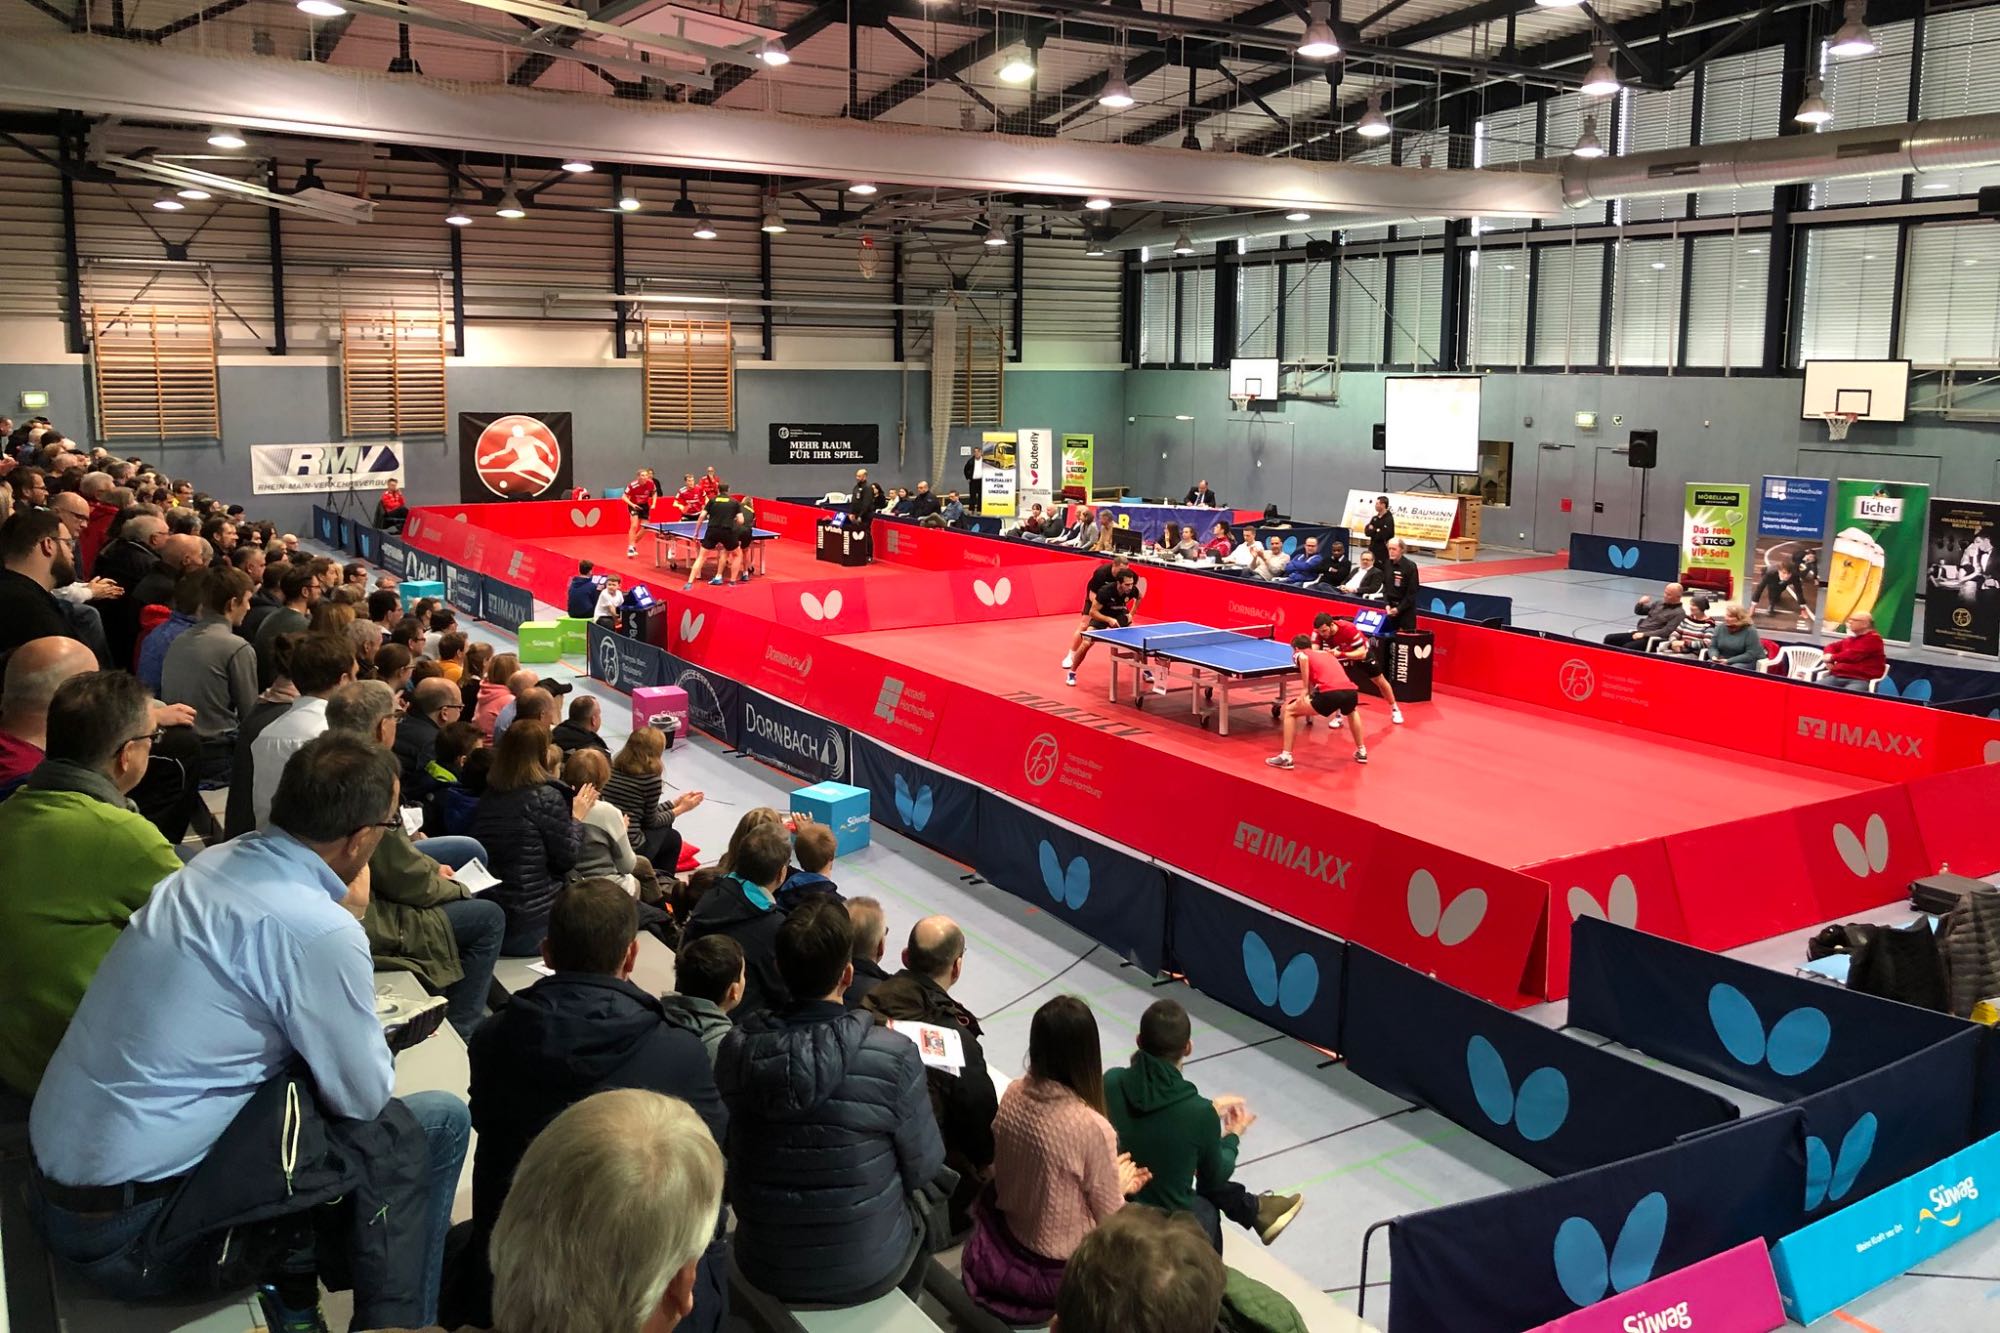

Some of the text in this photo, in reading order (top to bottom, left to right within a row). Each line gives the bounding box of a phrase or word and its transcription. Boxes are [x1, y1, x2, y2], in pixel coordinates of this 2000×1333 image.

[789, 441, 851, 449] MEHR RAUM
[789, 450, 864, 459] FÜR IHR SPIEL.
[1031, 431, 1040, 469] Butterfly
[1411, 507, 1454, 517] BAUMANN
[1860, 501, 1899, 515] Licher
[1693, 525, 1731, 535] Das rote
[1691, 548, 1729, 559] VIP-Sofa
[1397, 644, 1409, 683] BUTTERFLY
[746, 702, 819, 760] DORNBACH
[1831, 722, 1923, 759] IMAXX
[1263, 832, 1352, 890] IMAXX
[1929, 1176, 1979, 1212] Süwag
[1623, 1301, 1692, 1333] Süwag
